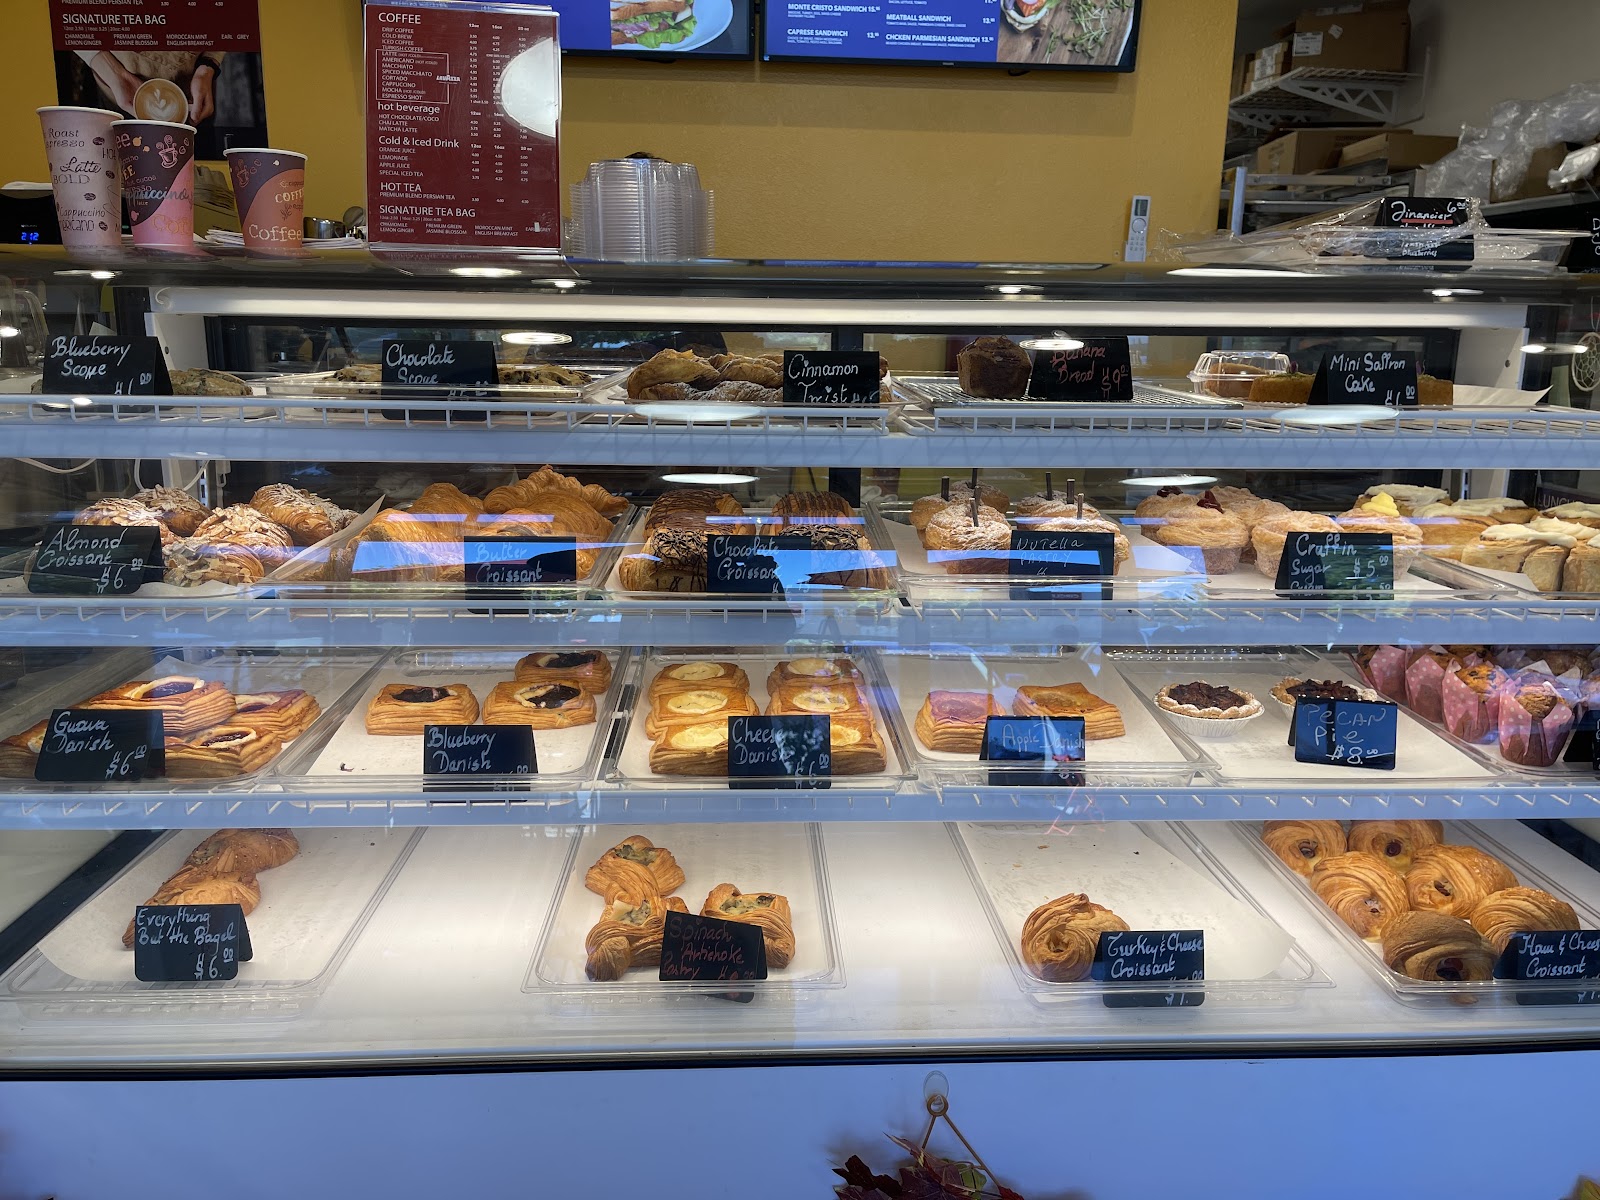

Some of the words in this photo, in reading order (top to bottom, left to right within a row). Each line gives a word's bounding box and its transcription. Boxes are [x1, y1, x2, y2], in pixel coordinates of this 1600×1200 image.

[62, 14, 121, 24] SIGNATURE
[122, 14, 143, 24] TEA
[145, 14, 166, 25] BAG
[378, 12, 421, 24] COFFEE
[378, 102, 394, 111] hot
[396, 103, 440, 115] beverage
[391, 114, 440, 122] CHOCOLATE/COCO
[48, 128, 79, 139] Roast
[379, 136, 400, 145] Cold
[403, 137, 410, 146] &
[412, 137, 432, 146] Iced
[434, 138, 460, 148] Drink
[60, 156, 102, 174] Latte
[53, 174, 91, 185] BOLD
[380, 182, 402, 191] HOT
[403, 183, 422, 192] TEA
[59, 206, 106, 219] Cappuccino
[379, 205, 434, 216] SIGNATURE
[435, 207, 454, 217] TEA
[456, 208, 476, 218] BAG
[249, 224, 302, 242] Coffee
[50, 335, 131, 367] Blueberry
[385, 343, 456, 368] Chocolate
[1330, 353, 1361, 372] Mini
[1364, 352, 1406, 372] Saffron
[788, 354, 859, 380] Cinnamon
[798, 380, 848, 403] Twist
[1345, 374, 1376, 393] Cake
[44, 526, 128, 552] Almond
[713, 536, 780, 558] Chocolate
[475, 542, 528, 563] Butter
[476, 560, 543, 583] Croissant
[1290, 559, 1332, 585] Sugar
[53, 711, 110, 735] Guava
[46, 731, 114, 754] Danish
[427, 726, 497, 755] Blueberry
[1002, 724, 1040, 752] Apple
[1033, 722, 1084, 750] Danish
[433, 750, 492, 773] Danish
[136, 907, 210, 936] Everything
[138, 927, 164, 946] But
[169, 926, 189, 945] the
[194, 922, 236, 956] Bagel
[670, 916, 733, 951] Spinach
[1559, 934, 1566, 956] &
[1569, 932, 1600, 952] Chees
[1107, 932, 1158, 964] Turkey
[1167, 932, 1204, 952] Cheese
[1111, 954, 1176, 979] Croissant
[1526, 955, 1586, 978] Croissant
